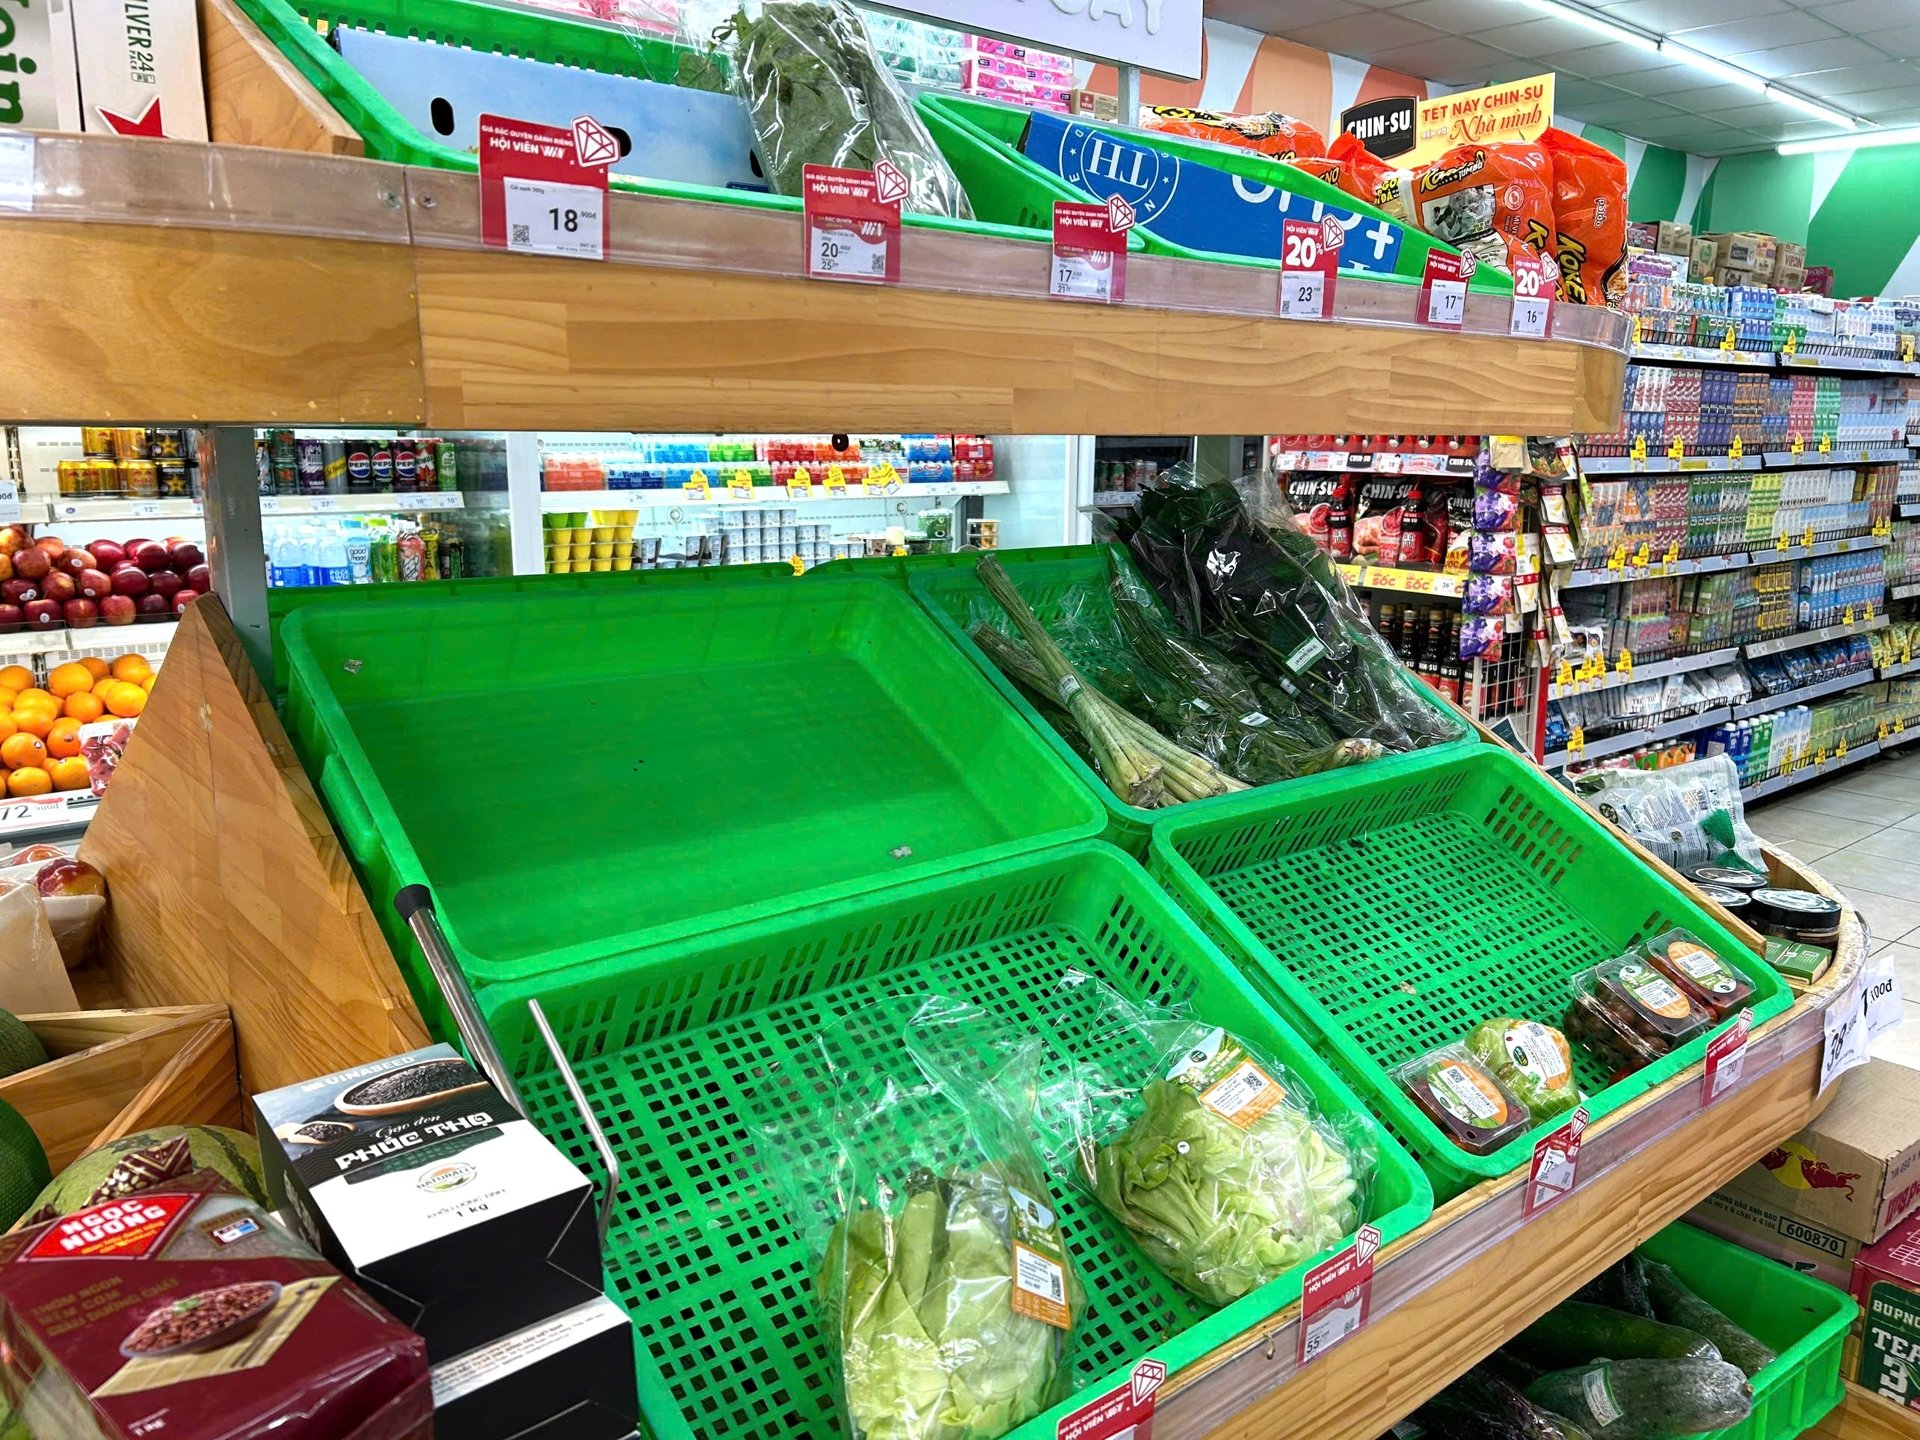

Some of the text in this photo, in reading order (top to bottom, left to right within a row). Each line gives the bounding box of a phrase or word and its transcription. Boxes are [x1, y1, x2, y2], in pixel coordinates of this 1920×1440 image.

[1483, 84, 1544, 109] CHIN-SU
[1347, 109, 1411, 139] CHIN-SU
[1449, 103, 1543, 143] Nhà mình
[490, 137, 511, 151] HỘI
[512, 140, 539, 155] VIÊN
[812, 183, 828, 195] HỘI
[830, 184, 849, 196] VIÊN
[549, 207, 578, 233] 18
[1060, 216, 1072, 227] HỘI
[1073, 217, 1089, 227] VIÊN
[821, 242, 839, 258] 20
[1285, 235, 1324, 268] 20%
[822, 261, 833, 271] 25
[1059, 269, 1072, 283] 17
[1298, 287, 1312, 302] 23
[1445, 295, 1456, 310] 17
[1527, 310, 1537, 324] 16
[1288, 481, 1337, 495] CHIN-SU
[1361, 483, 1413, 499] CHIN-SU
[350, 548, 366, 557] good
[425, 541, 434, 569] TEA
[325, 1055, 415, 1085] VINASEED
[335, 1111, 494, 1171] PHÚC THỌ
[416, 1165, 477, 1190] NATURALLY
[456, 1203, 489, 1218] 1 kg
[1787, 1223, 1838, 1252] 600870
[1308, 1282, 1321, 1294] HỘI
[1322, 1273, 1337, 1287] VIÊN
[1306, 1336, 1320, 1354] 55
[1065, 1426, 1081, 1440] HỘI
[1083, 1415, 1104, 1431] VIÊN
